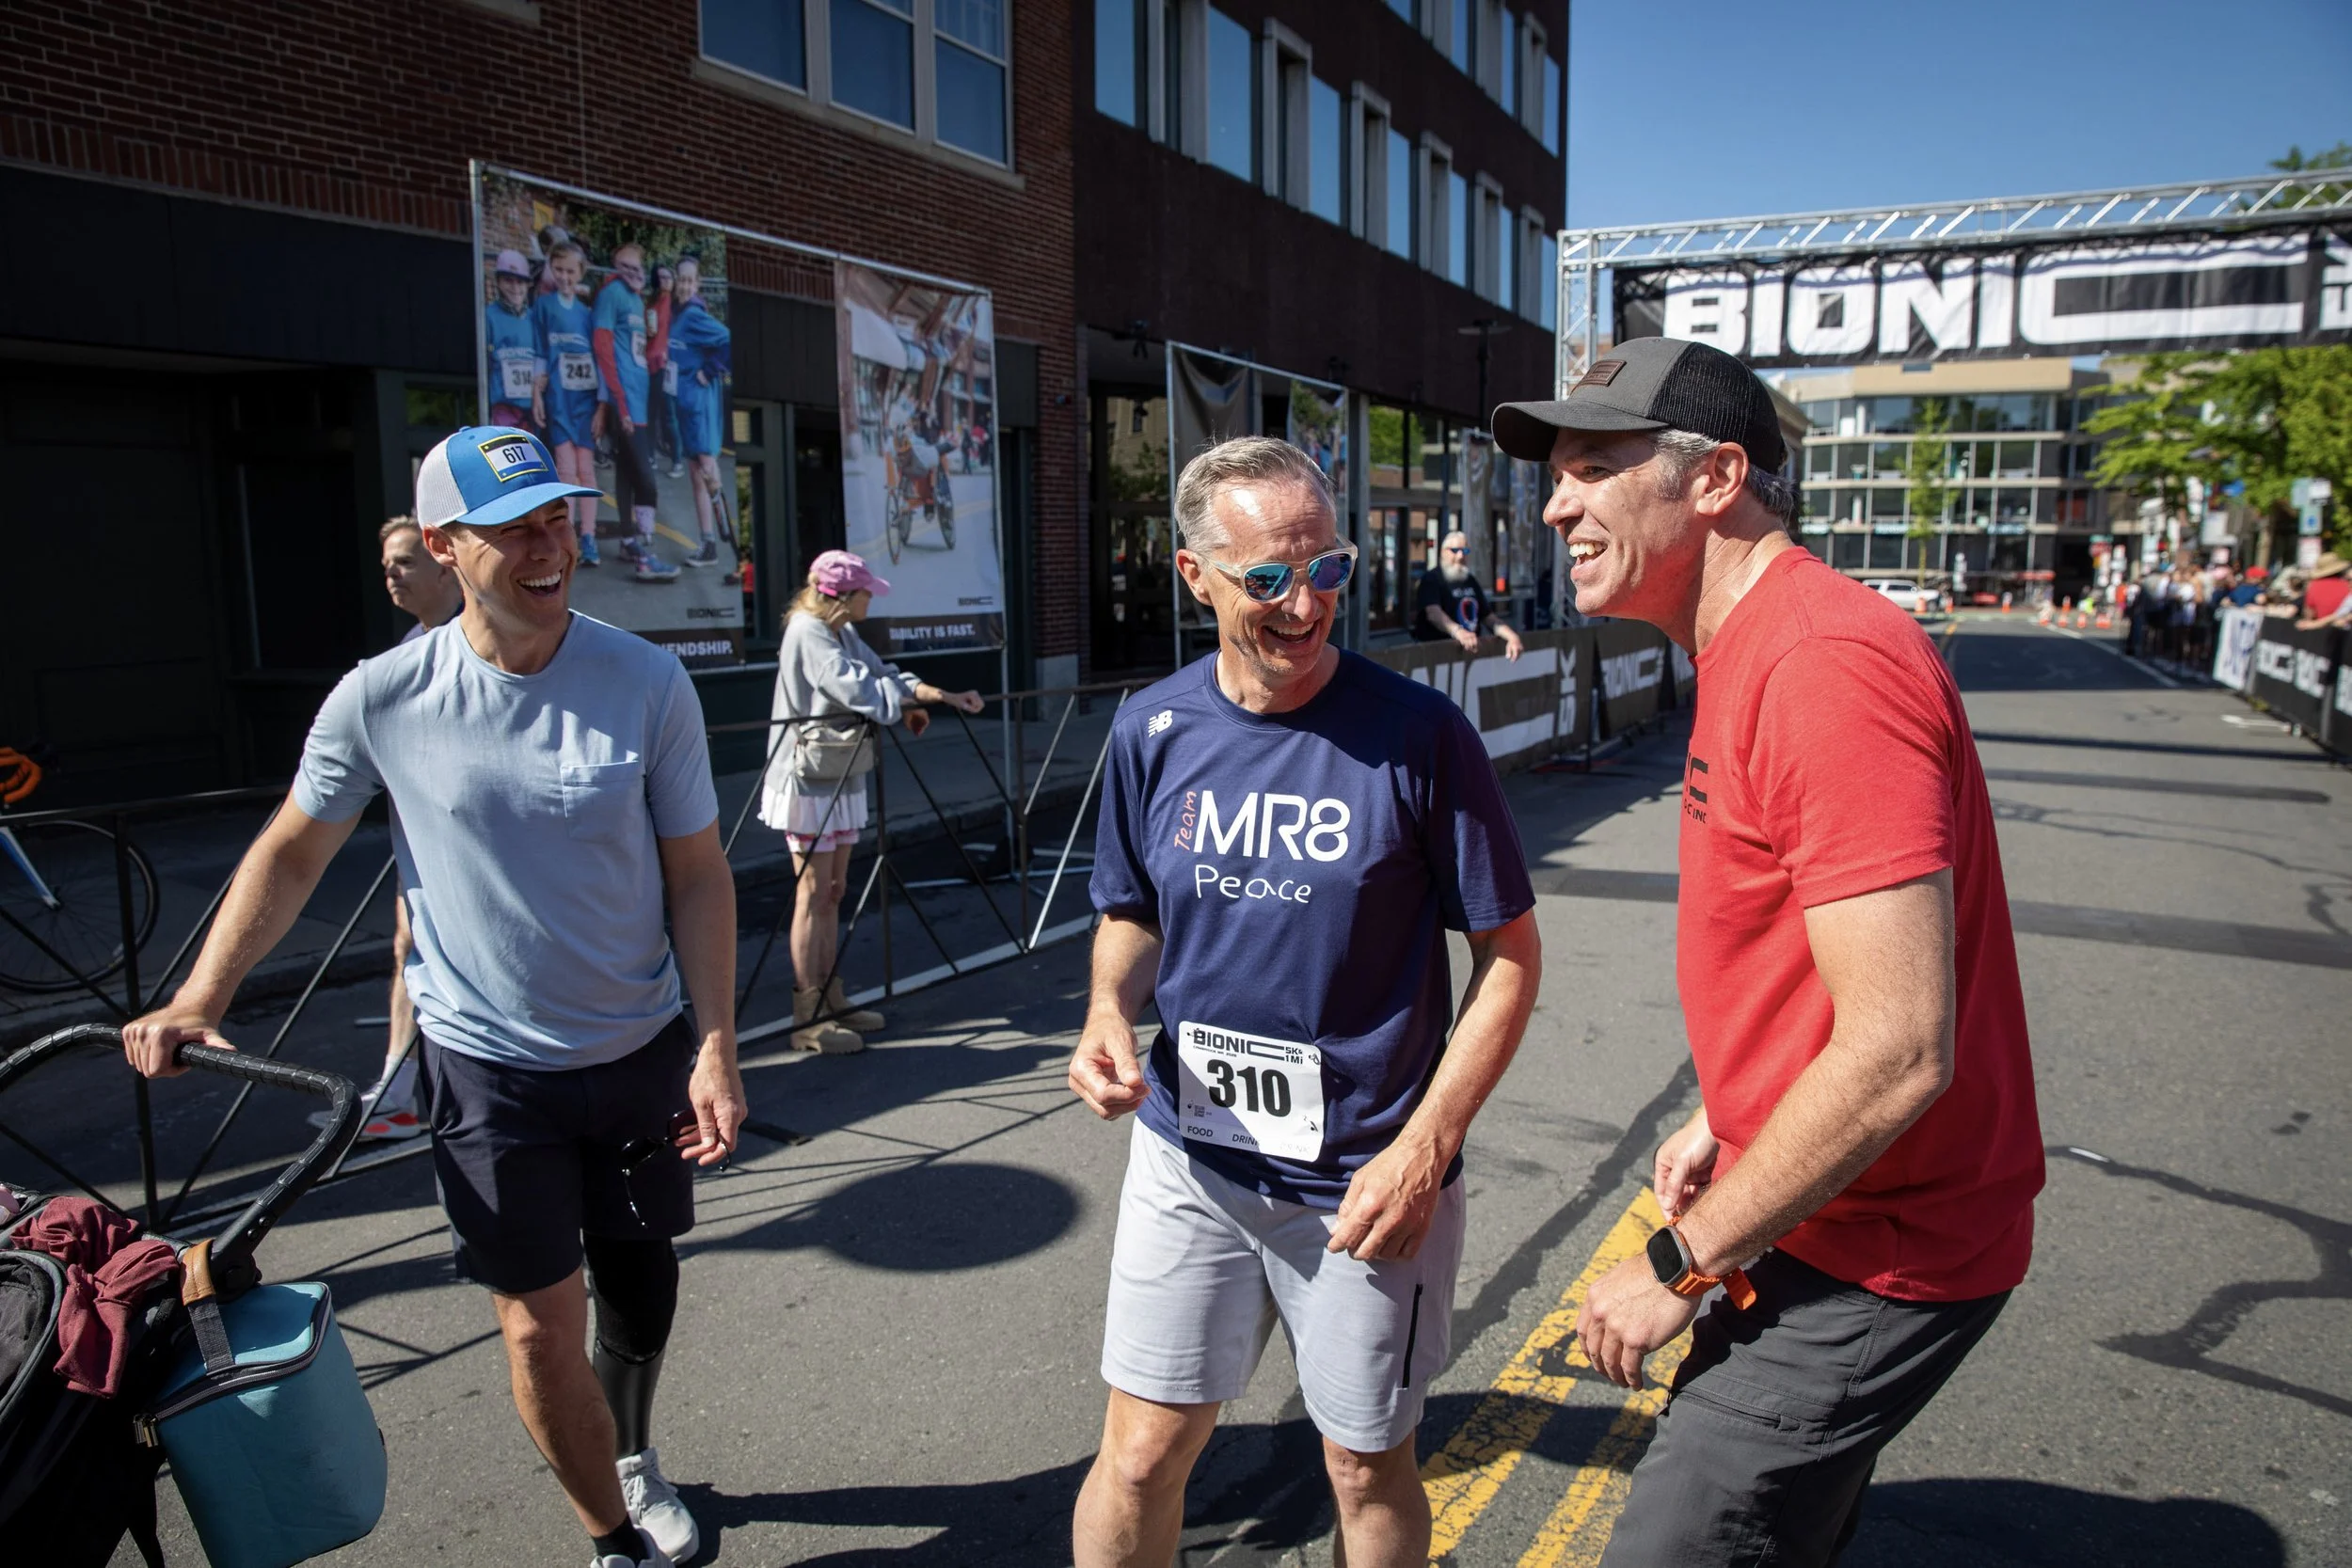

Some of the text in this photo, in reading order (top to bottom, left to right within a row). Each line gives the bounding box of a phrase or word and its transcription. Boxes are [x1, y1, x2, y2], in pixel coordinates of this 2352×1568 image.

[1663, 234, 2310, 356] BIONIC
[566, 363, 592, 379] 242
[502, 446, 527, 463] 617
[1174, 789, 1351, 863] Team MR8
[1194, 863, 1311, 904] Peace
[1193, 1029, 1285, 1061] BIONIC
[1207, 1059, 1291, 1117] 310
[1187, 1125, 1214, 1138] FOOD
